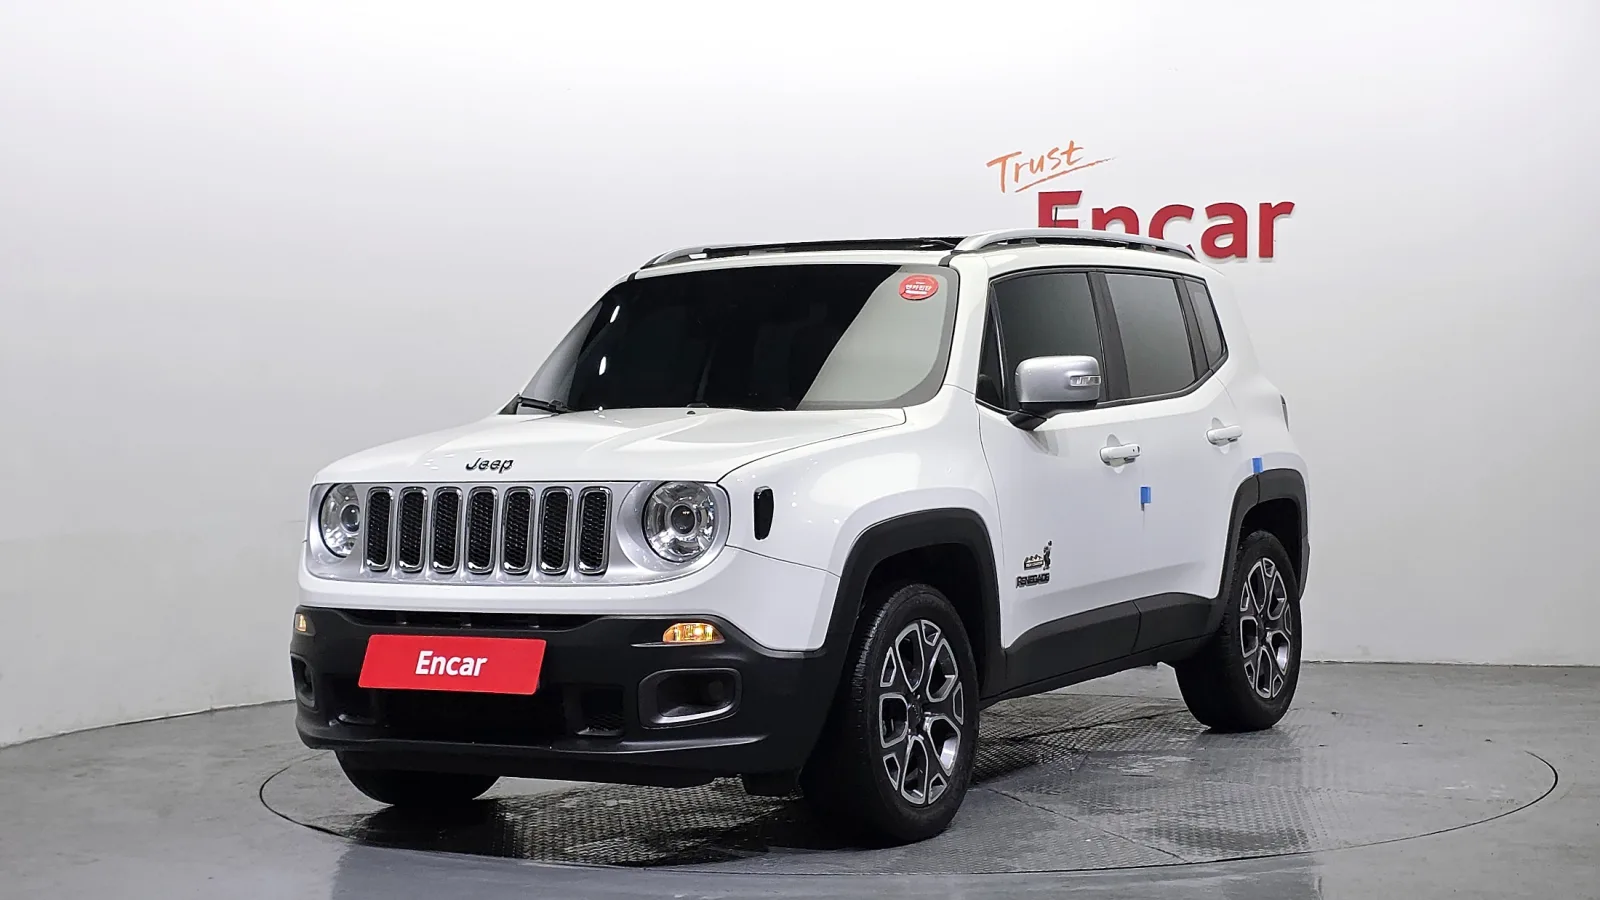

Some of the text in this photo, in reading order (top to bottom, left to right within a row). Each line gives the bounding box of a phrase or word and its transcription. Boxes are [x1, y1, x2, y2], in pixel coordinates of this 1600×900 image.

[986, 140, 1085, 193] Trust
[465, 457, 514, 474] Jeep
[415, 650, 488, 677] Encar
